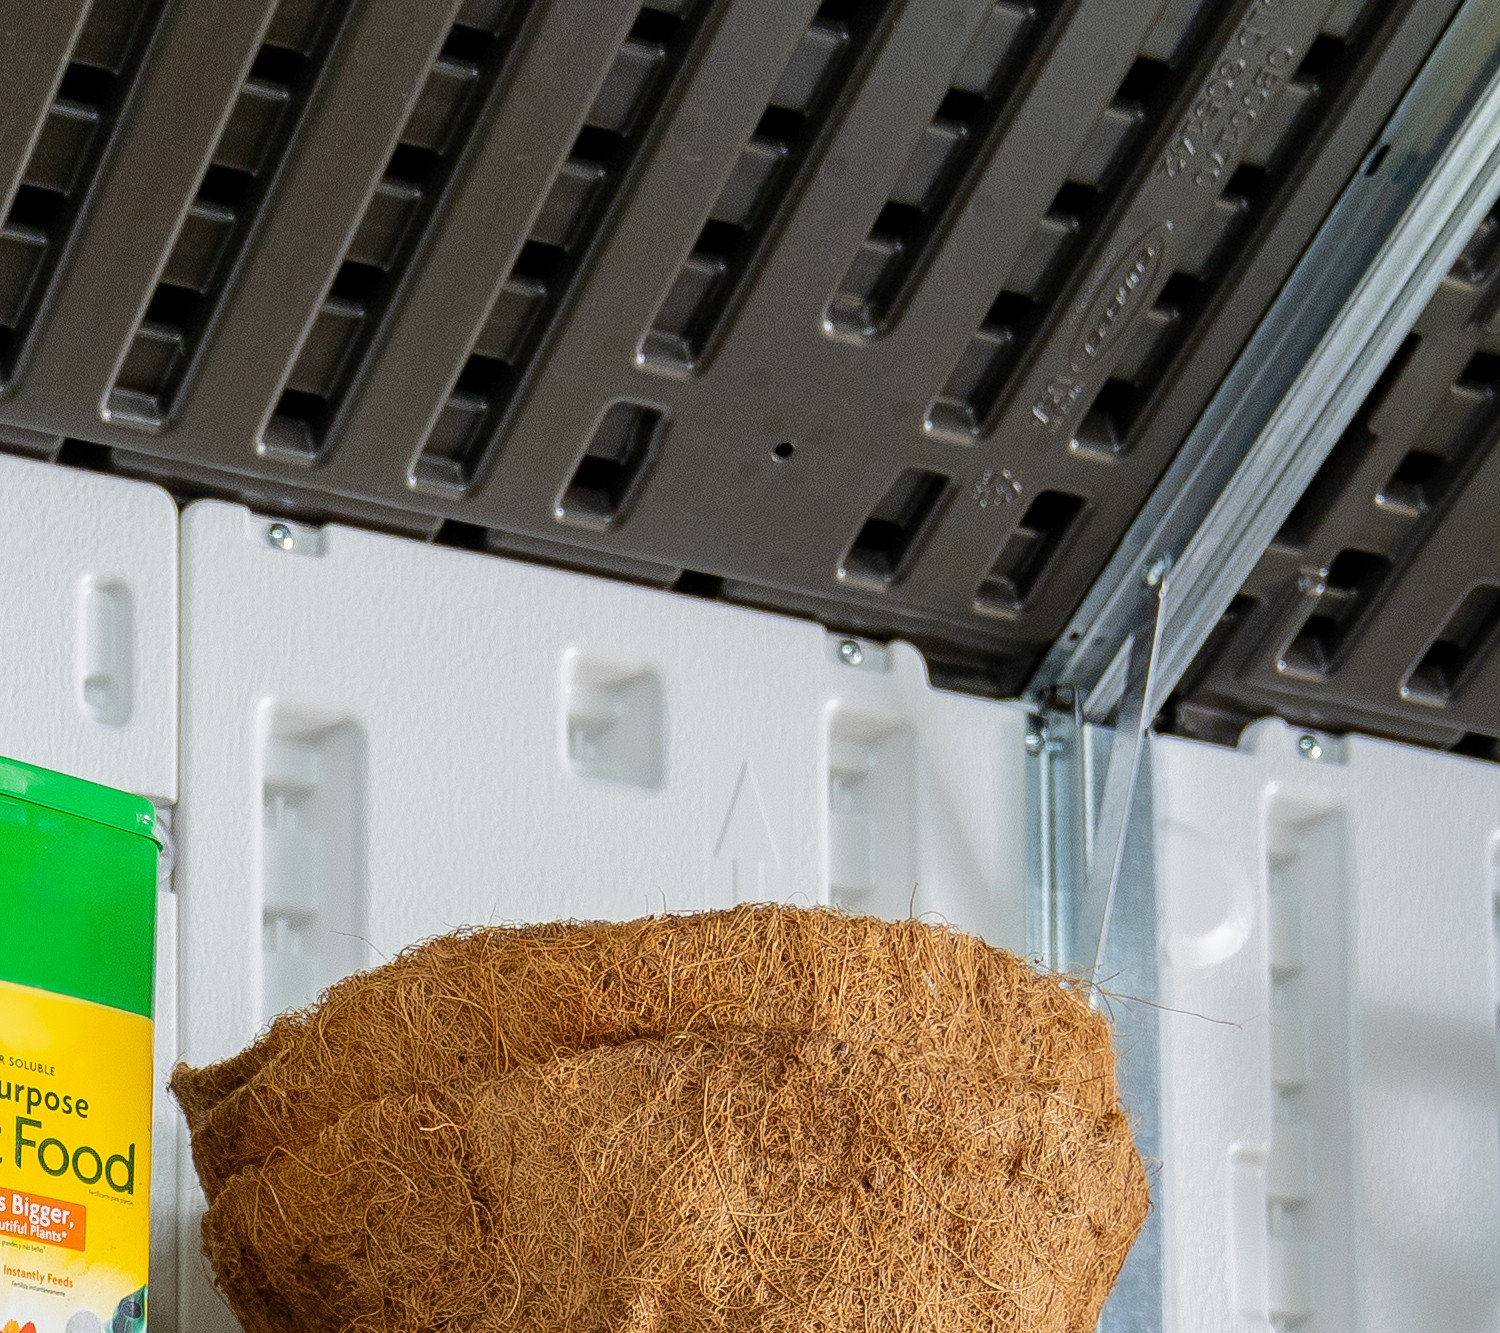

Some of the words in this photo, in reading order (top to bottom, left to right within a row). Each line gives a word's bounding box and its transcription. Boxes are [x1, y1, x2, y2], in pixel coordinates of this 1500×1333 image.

[9, 1056, 56, 1076] SOLUBLE
[15, 1116, 135, 1195] Food
[12, 1194, 75, 1229] Bigger,
[3, 1264, 45, 1284] Instantly
[47, 1273, 74, 1288] Feeds
